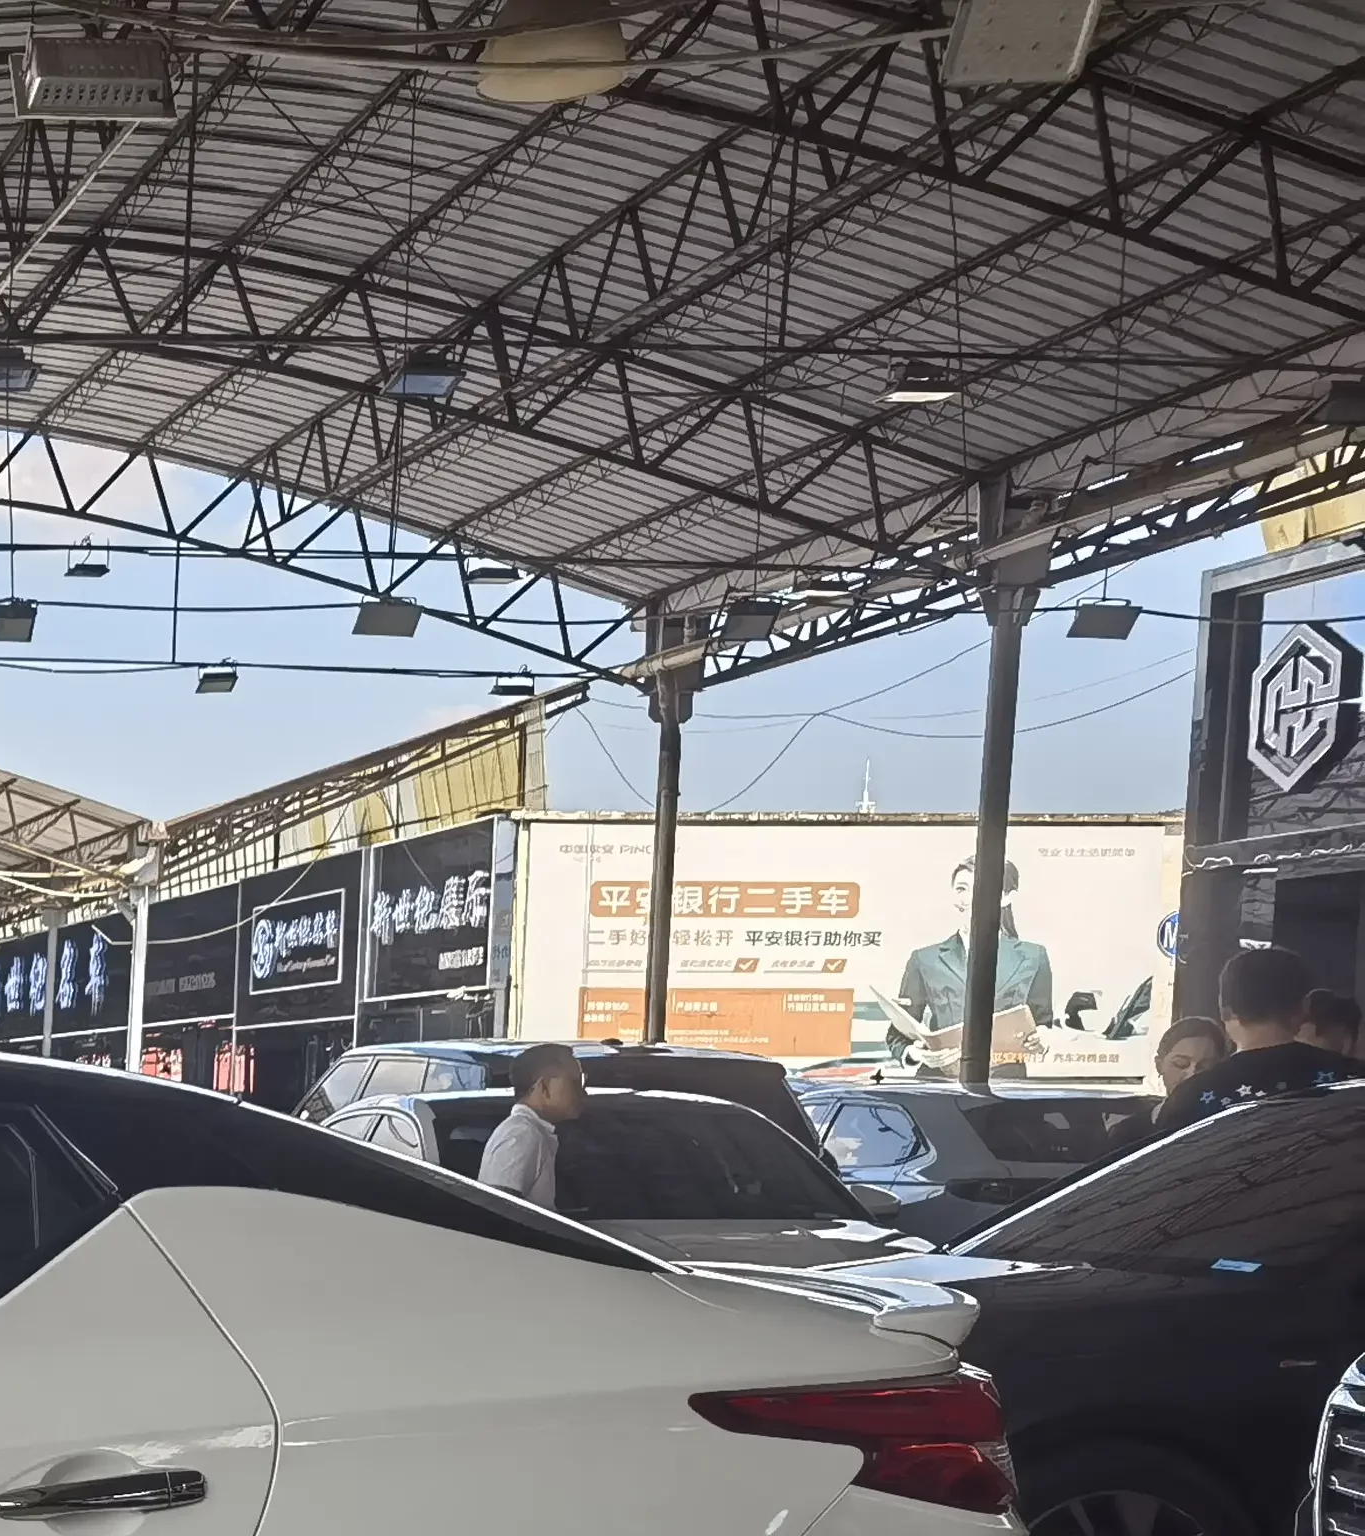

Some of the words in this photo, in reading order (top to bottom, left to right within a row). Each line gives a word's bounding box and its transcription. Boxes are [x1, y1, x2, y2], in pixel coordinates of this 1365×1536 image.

[587, 929, 734, 948] 二手好轻松开
[744, 929, 883, 948] 平安银行助你买
